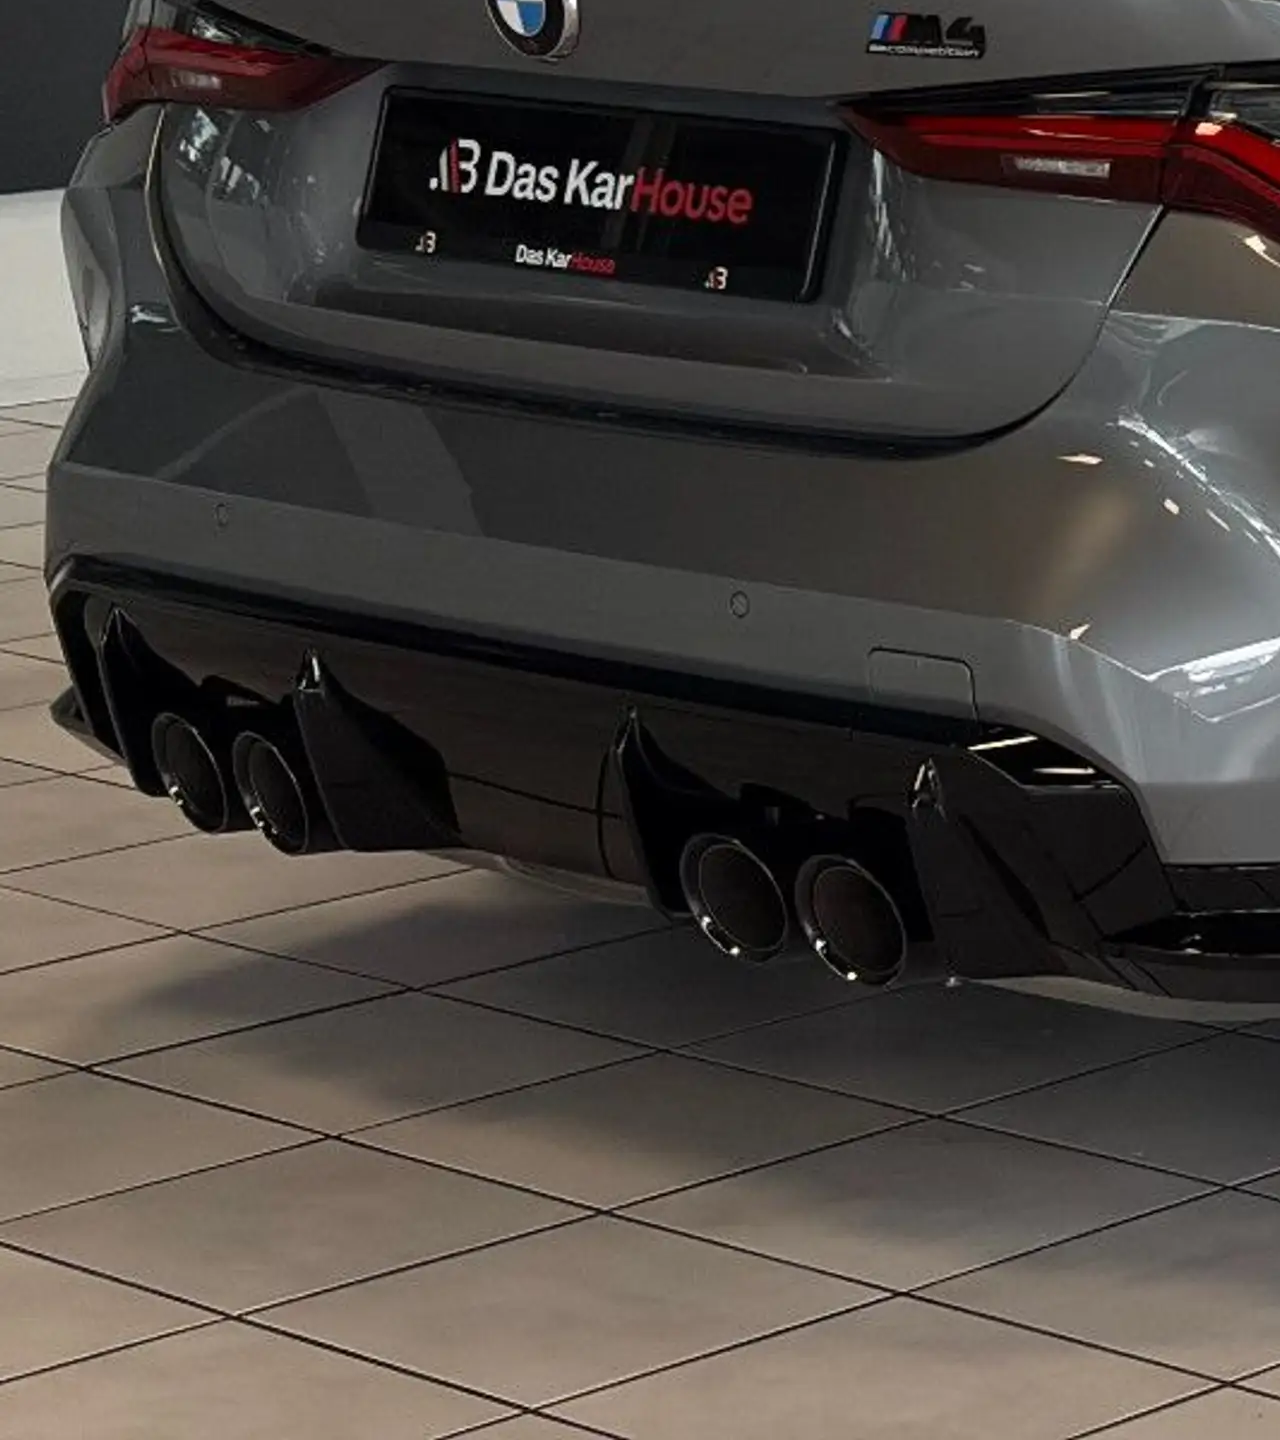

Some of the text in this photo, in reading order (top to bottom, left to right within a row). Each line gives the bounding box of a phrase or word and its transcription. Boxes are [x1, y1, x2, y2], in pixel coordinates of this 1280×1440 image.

[484, 150, 559, 203] Das
[562, 158, 754, 224] KarHouse
[515, 244, 616, 275] Das KarHouse
